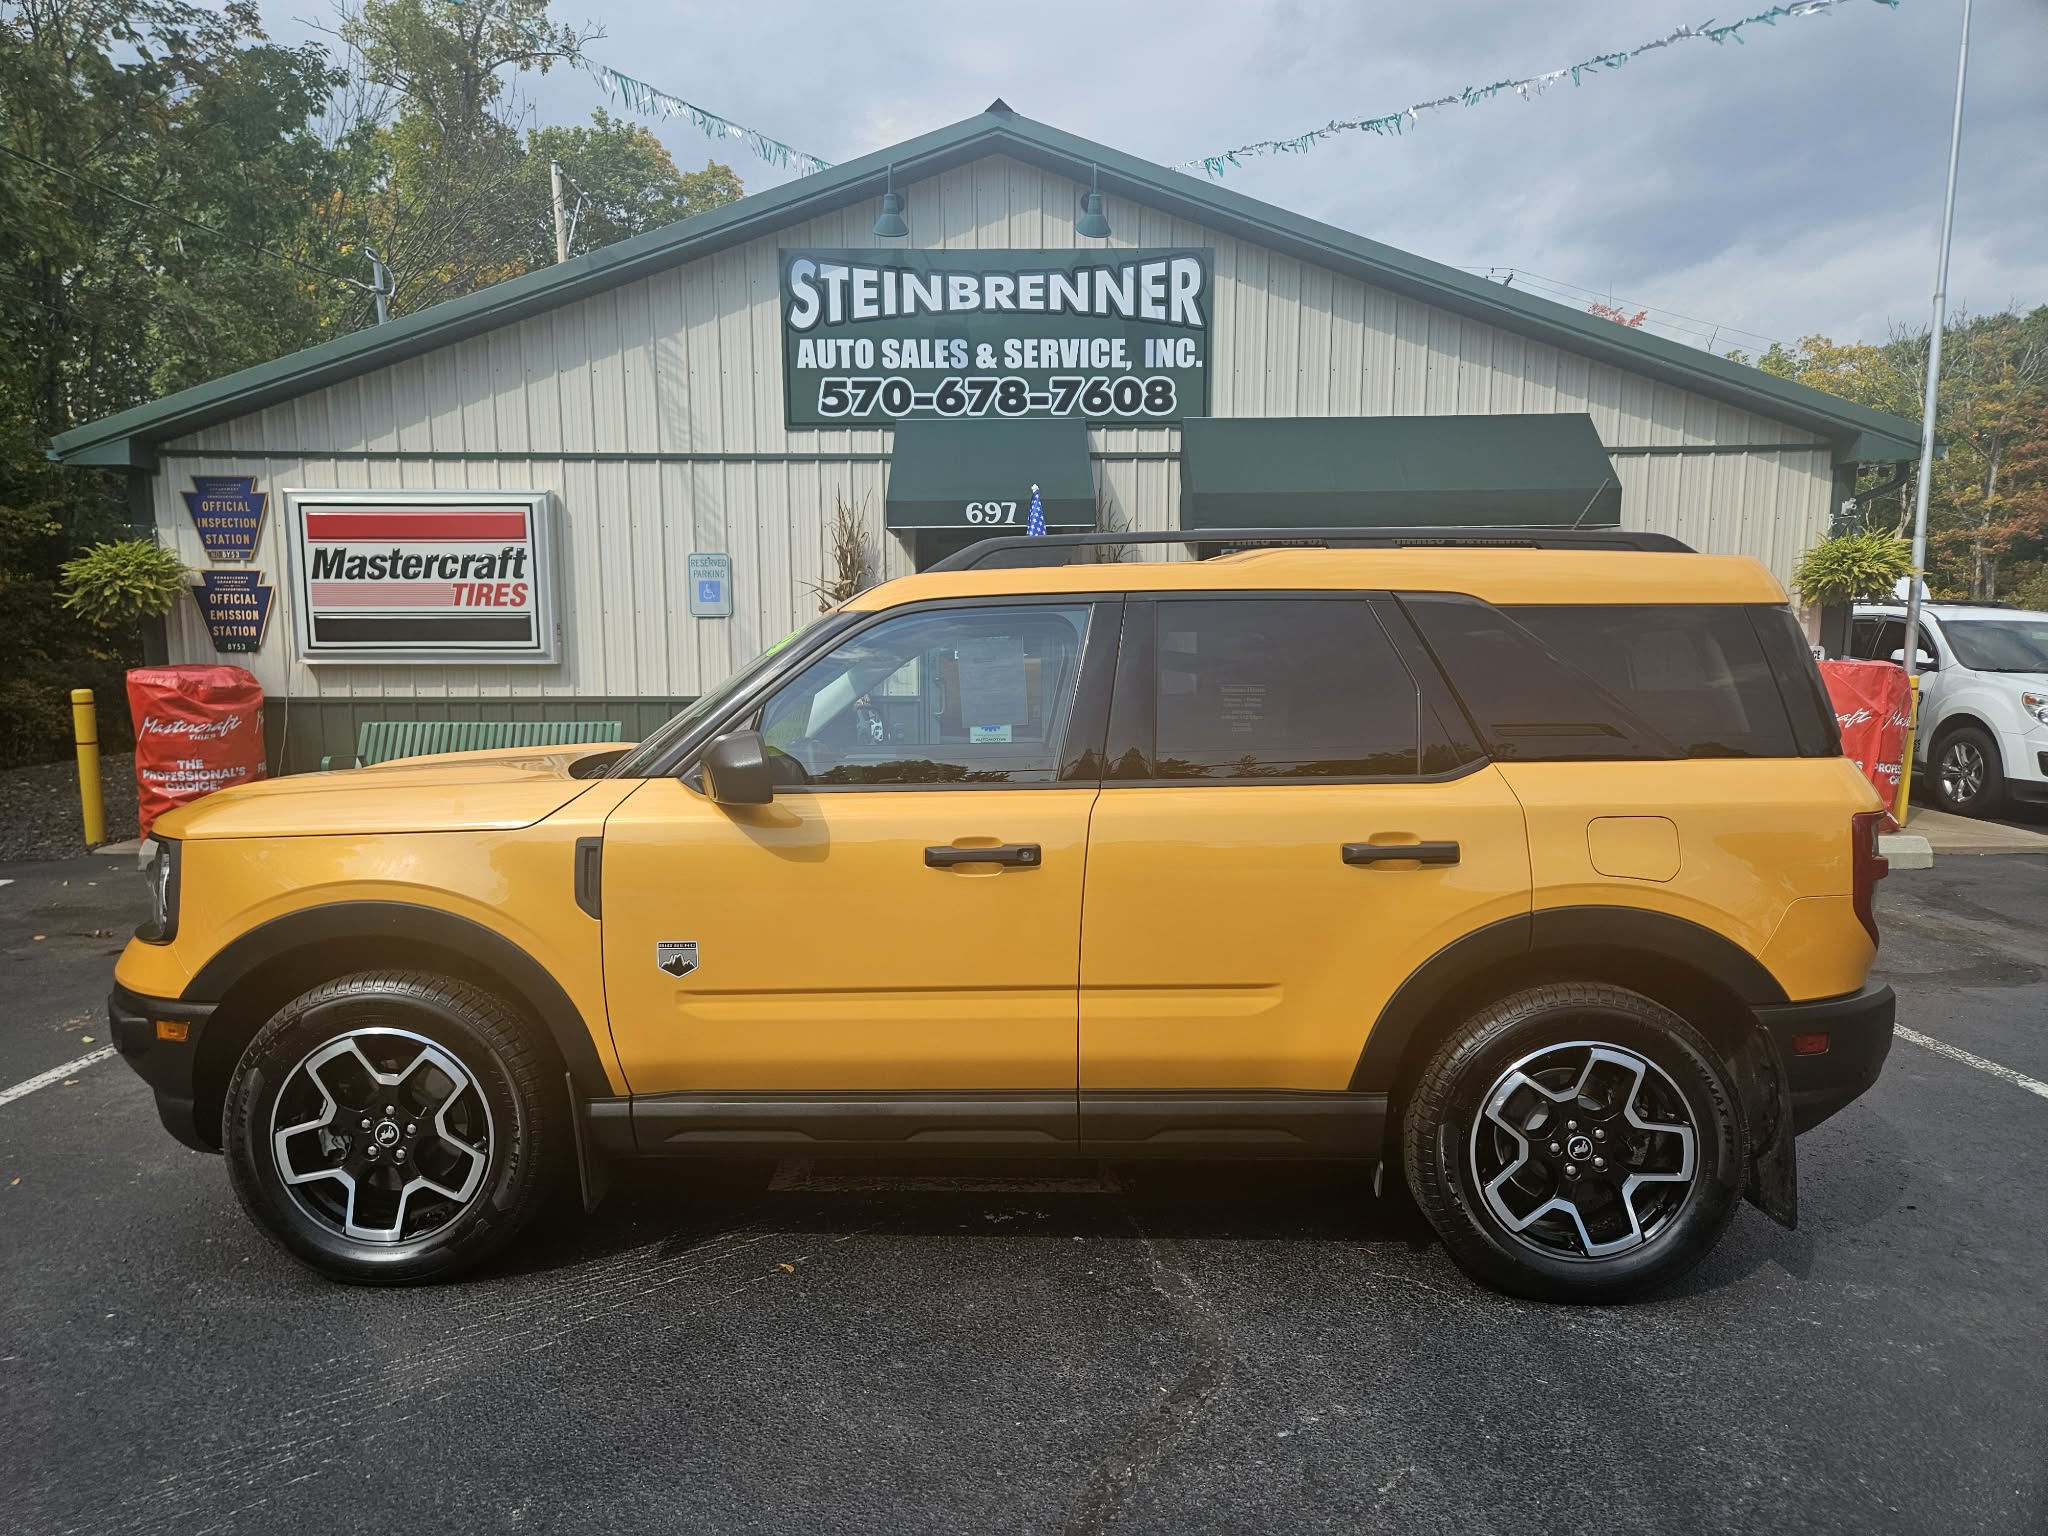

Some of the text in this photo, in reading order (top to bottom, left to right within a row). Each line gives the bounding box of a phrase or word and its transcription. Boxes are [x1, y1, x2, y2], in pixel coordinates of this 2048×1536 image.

[790, 257, 1203, 329] STEINBRENNER
[797, 338, 1203, 371] AUTO SALES & SERVICE, INC.
[818, 376, 1177, 417] 570-678-7608
[202, 501, 251, 512] OFFICIAL
[965, 501, 1017, 524] 697
[197, 518, 257, 528] INSPECTION
[205, 534, 250, 544] STATION
[311, 547, 527, 580] Mastercraft
[690, 559, 727, 567] RESERVED
[693, 570, 725, 578] PARKING
[209, 593, 258, 604] OFFICIAL
[452, 582, 528, 607] TIRES
[210, 610, 259, 620] EMISSION
[213, 626, 257, 636] STATION
[139, 714, 243, 740] Mastercraft
[177, 759, 204, 769] THE
[142, 766, 246, 782] PROFESSIONAL'S
